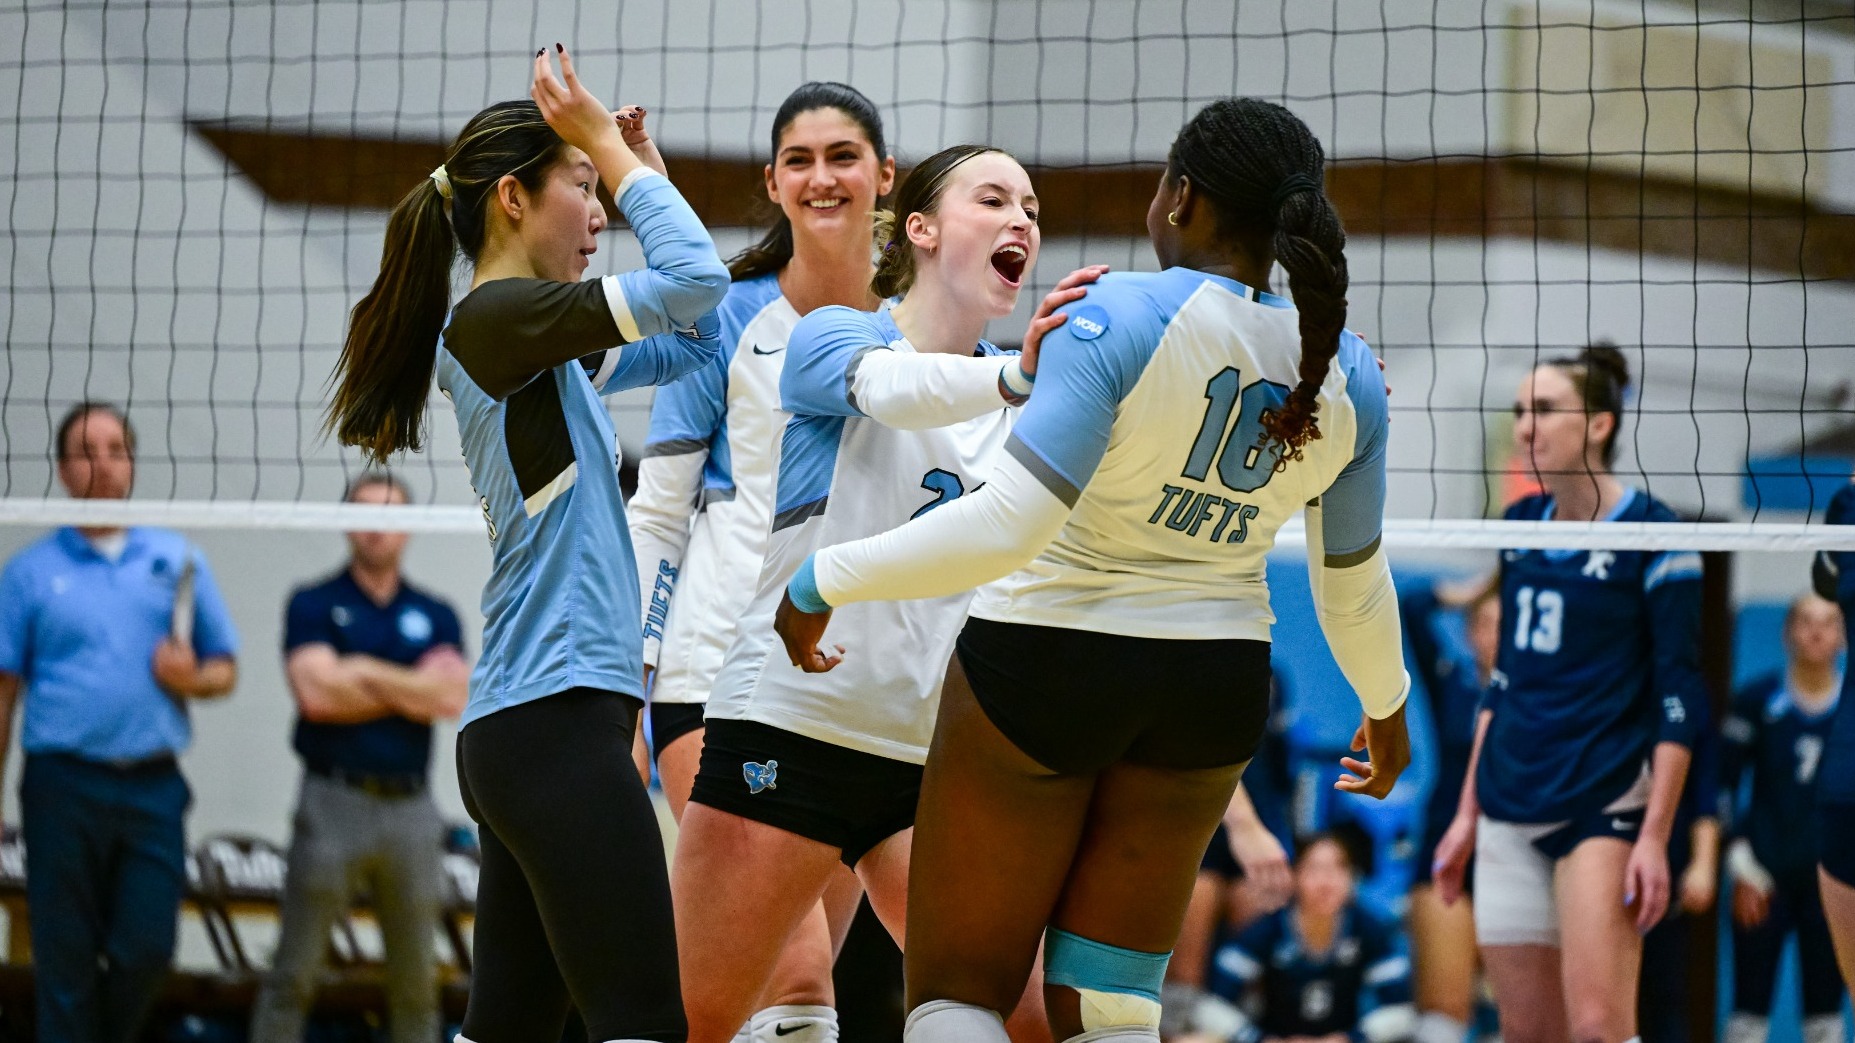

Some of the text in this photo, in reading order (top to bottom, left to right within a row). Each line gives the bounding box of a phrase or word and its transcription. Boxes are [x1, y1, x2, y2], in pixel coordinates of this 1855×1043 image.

[1072, 316, 1103, 335] NCAA
[1180, 365, 1292, 493] 16
[1147, 483, 1260, 543] TUFTS
[642, 559, 679, 642] TUFTS
[1514, 585, 1564, 654] 13
